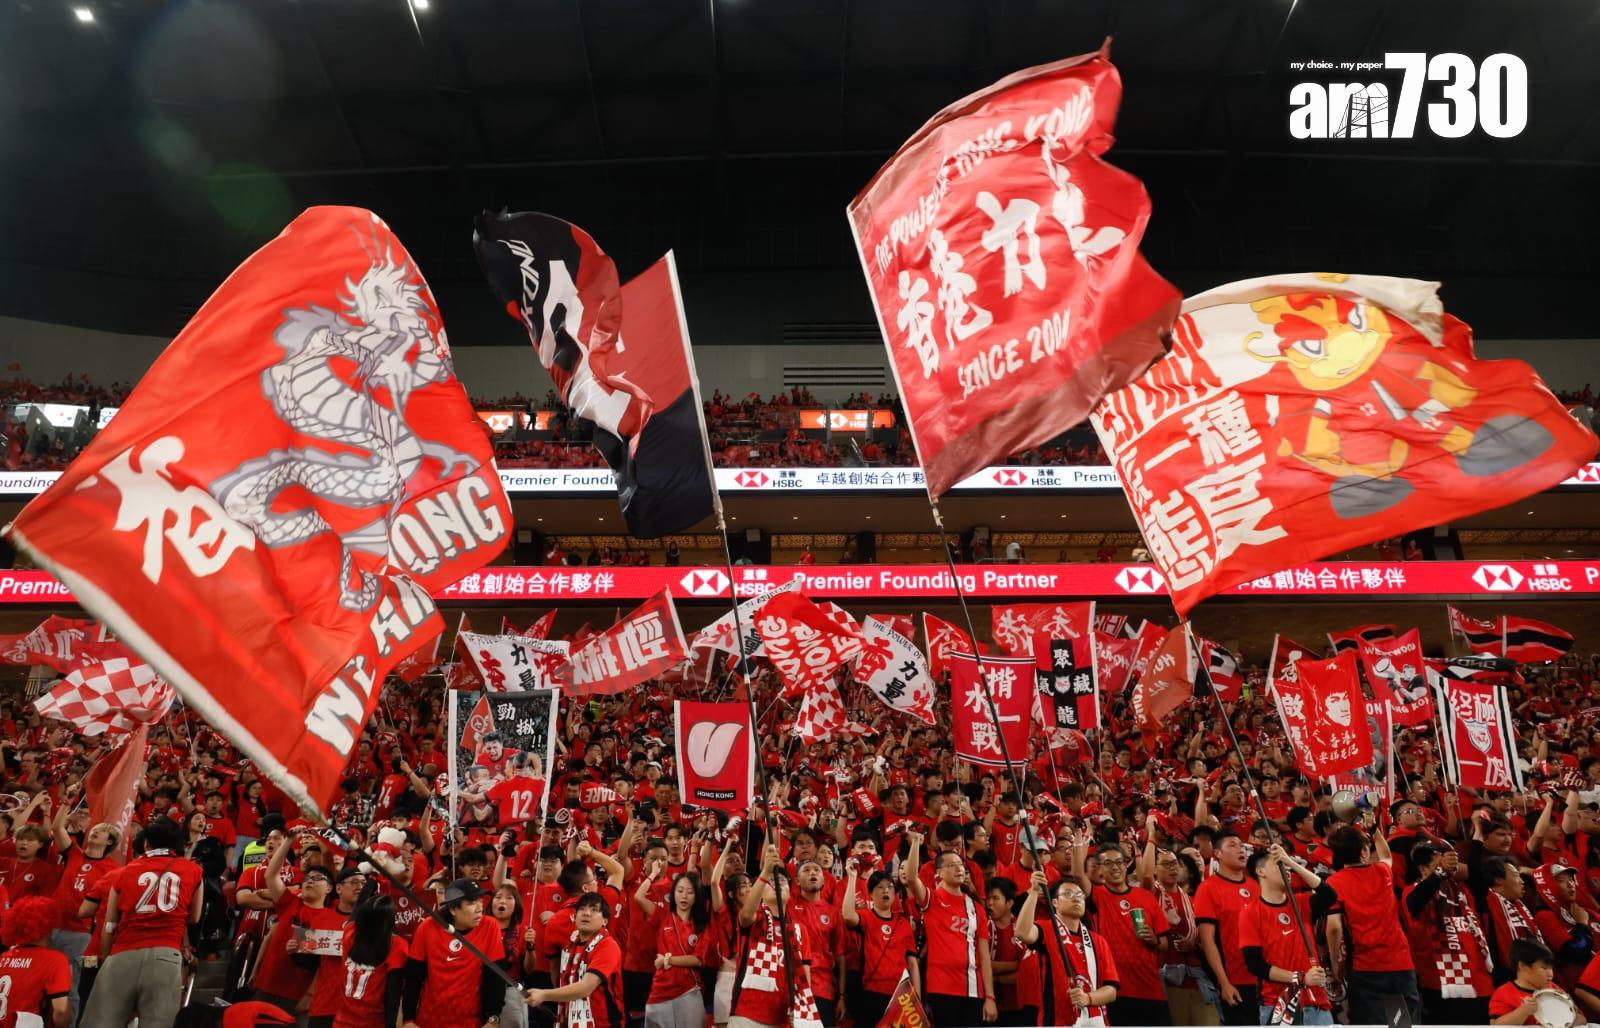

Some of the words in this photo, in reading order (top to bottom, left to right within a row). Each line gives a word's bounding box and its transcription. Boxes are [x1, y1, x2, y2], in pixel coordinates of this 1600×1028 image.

[957, 342, 1024, 400] SINCE
[500, 474, 556, 486] Premier
[772, 479, 803, 488] HSBC
[1031, 478, 1062, 486] HSBC
[880, 571, 976, 592] Founding
[983, 571, 1058, 589] Partner
[1238, 567, 1406, 590] 越創始合作夥伴
[1527, 578, 1572, 591] HSBC
[696, 790, 715, 799] HONG
[715, 791, 735, 800] KONG
[510, 789, 533, 819] 12
[135, 871, 182, 914] 20
